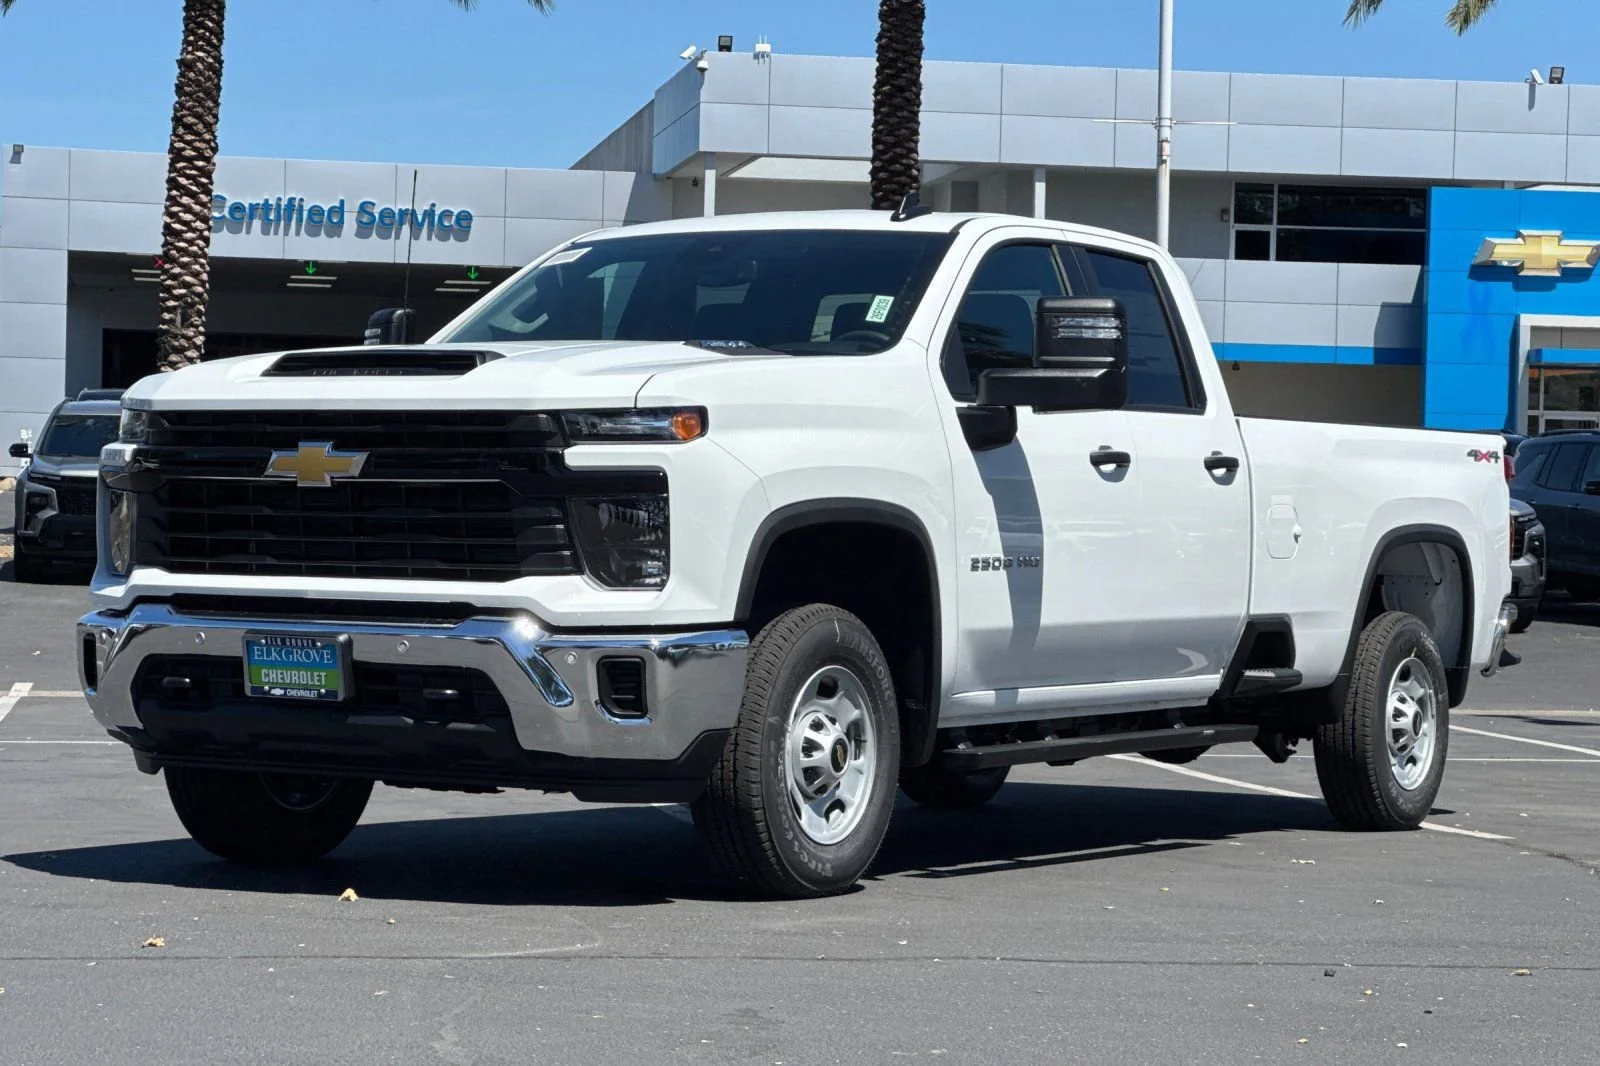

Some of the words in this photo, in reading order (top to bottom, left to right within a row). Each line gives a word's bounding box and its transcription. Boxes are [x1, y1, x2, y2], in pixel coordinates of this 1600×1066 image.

[211, 194, 345, 225] Certified
[357, 200, 473, 230] Service
[970, 556, 1013, 572] 2500
[261, 668, 327, 686] CHEVROLET
[286, 688, 318, 698] CHEVROLET
